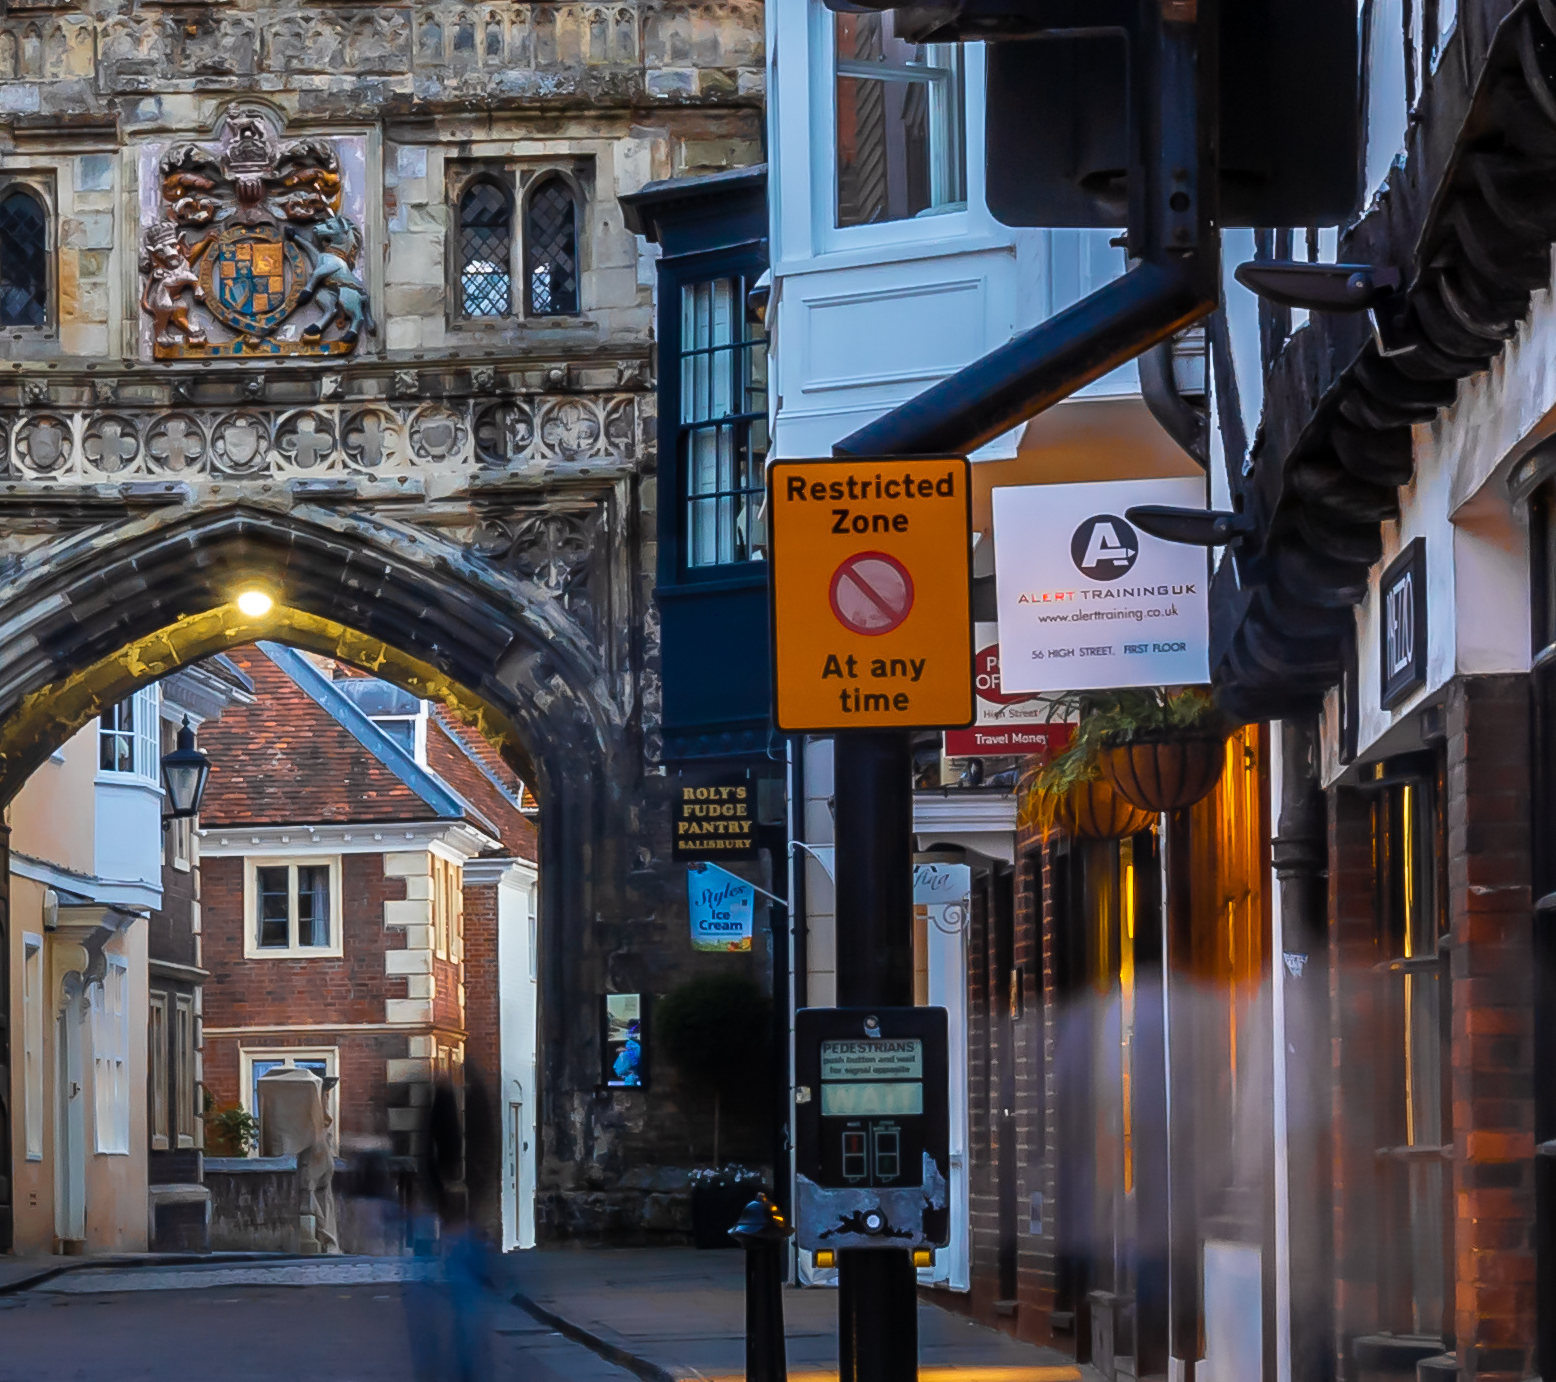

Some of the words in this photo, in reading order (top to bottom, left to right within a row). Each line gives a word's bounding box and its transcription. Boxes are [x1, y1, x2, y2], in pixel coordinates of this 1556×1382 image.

[787, 471, 954, 502] Restricted
[831, 508, 909, 534] Zone
[1018, 591, 1075, 605] ALERT
[1038, 603, 1179, 623] www.alerttraining.co.uk
[1031, 650, 1044, 660] 56
[1048, 648, 1075, 659] HIGH
[1123, 643, 1149, 654] FIRST
[1153, 642, 1186, 654] FLOOR
[822, 654, 858, 679] At
[871, 658, 926, 682] any
[840, 687, 910, 712] time
[1009, 709, 1039, 719] Street
[975, 734, 1009, 745] Travel
[1012, 733, 1046, 745] Money
[683, 787, 747, 800] ROLY'S
[683, 804, 747, 817] FUDGE
[678, 820, 752, 835] PANTRY
[678, 839, 752, 849] SALISBURY
[711, 909, 731, 920] Ice
[699, 919, 743, 931] Cream
[823, 1042, 915, 1054] PEDESTRIANS
[878, 1055, 894, 1063] and
[896, 1055, 915, 1063] wait
